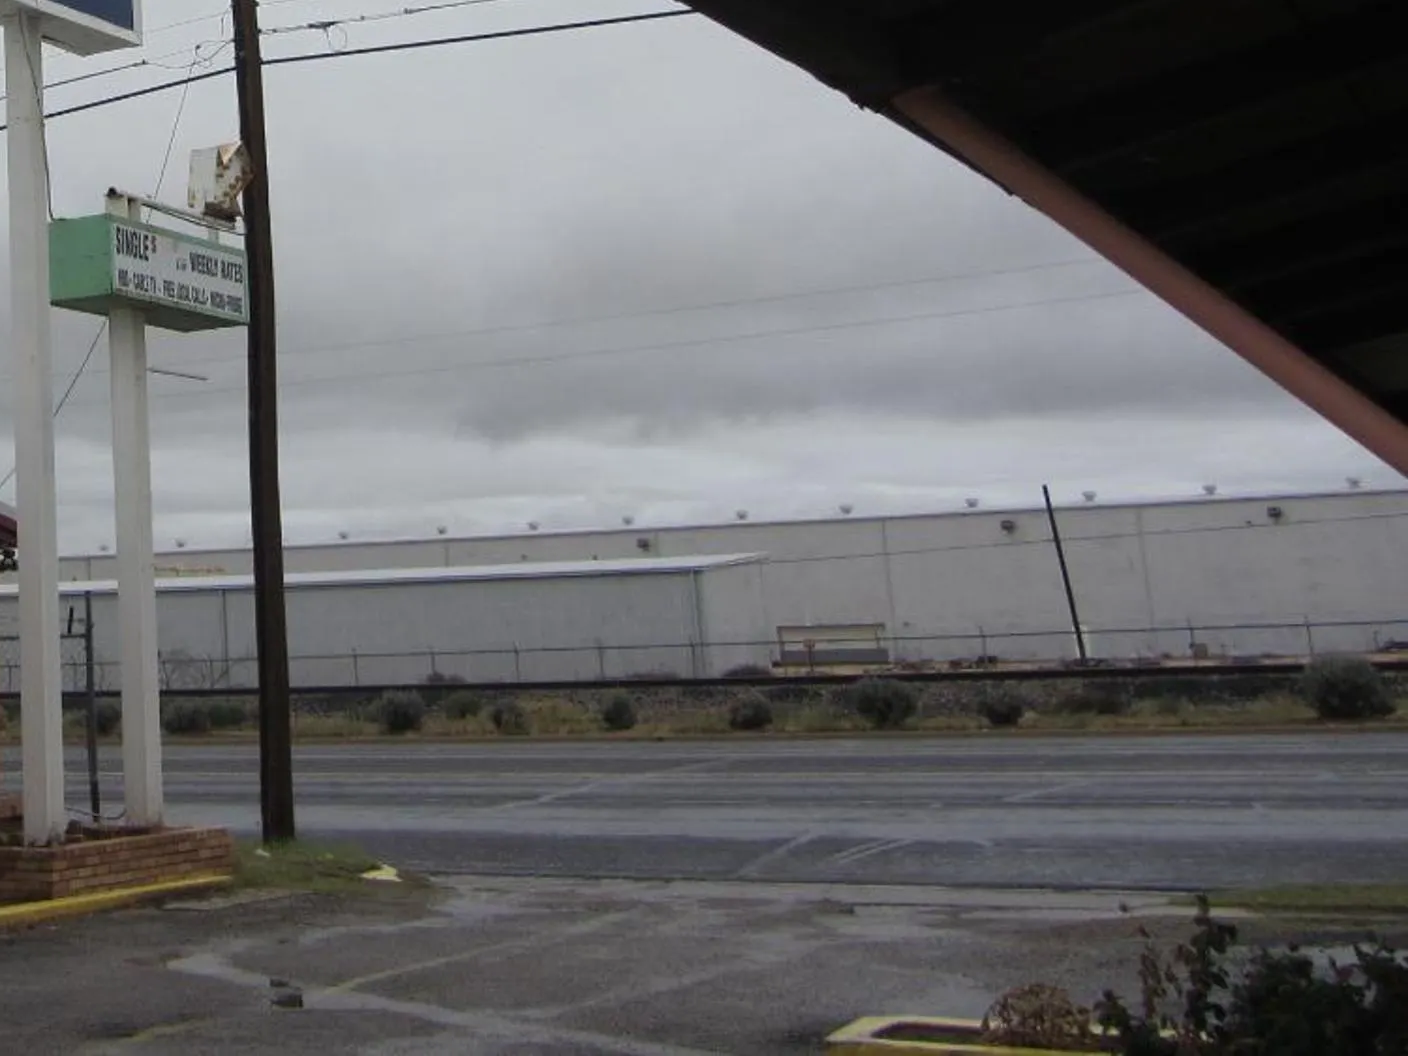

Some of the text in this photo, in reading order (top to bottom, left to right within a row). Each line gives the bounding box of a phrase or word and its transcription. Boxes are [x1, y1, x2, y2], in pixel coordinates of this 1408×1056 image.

[116, 225, 149, 262] SINGLE
[189, 251, 218, 277] WEEKLY
[220, 259, 243, 284] RATES
